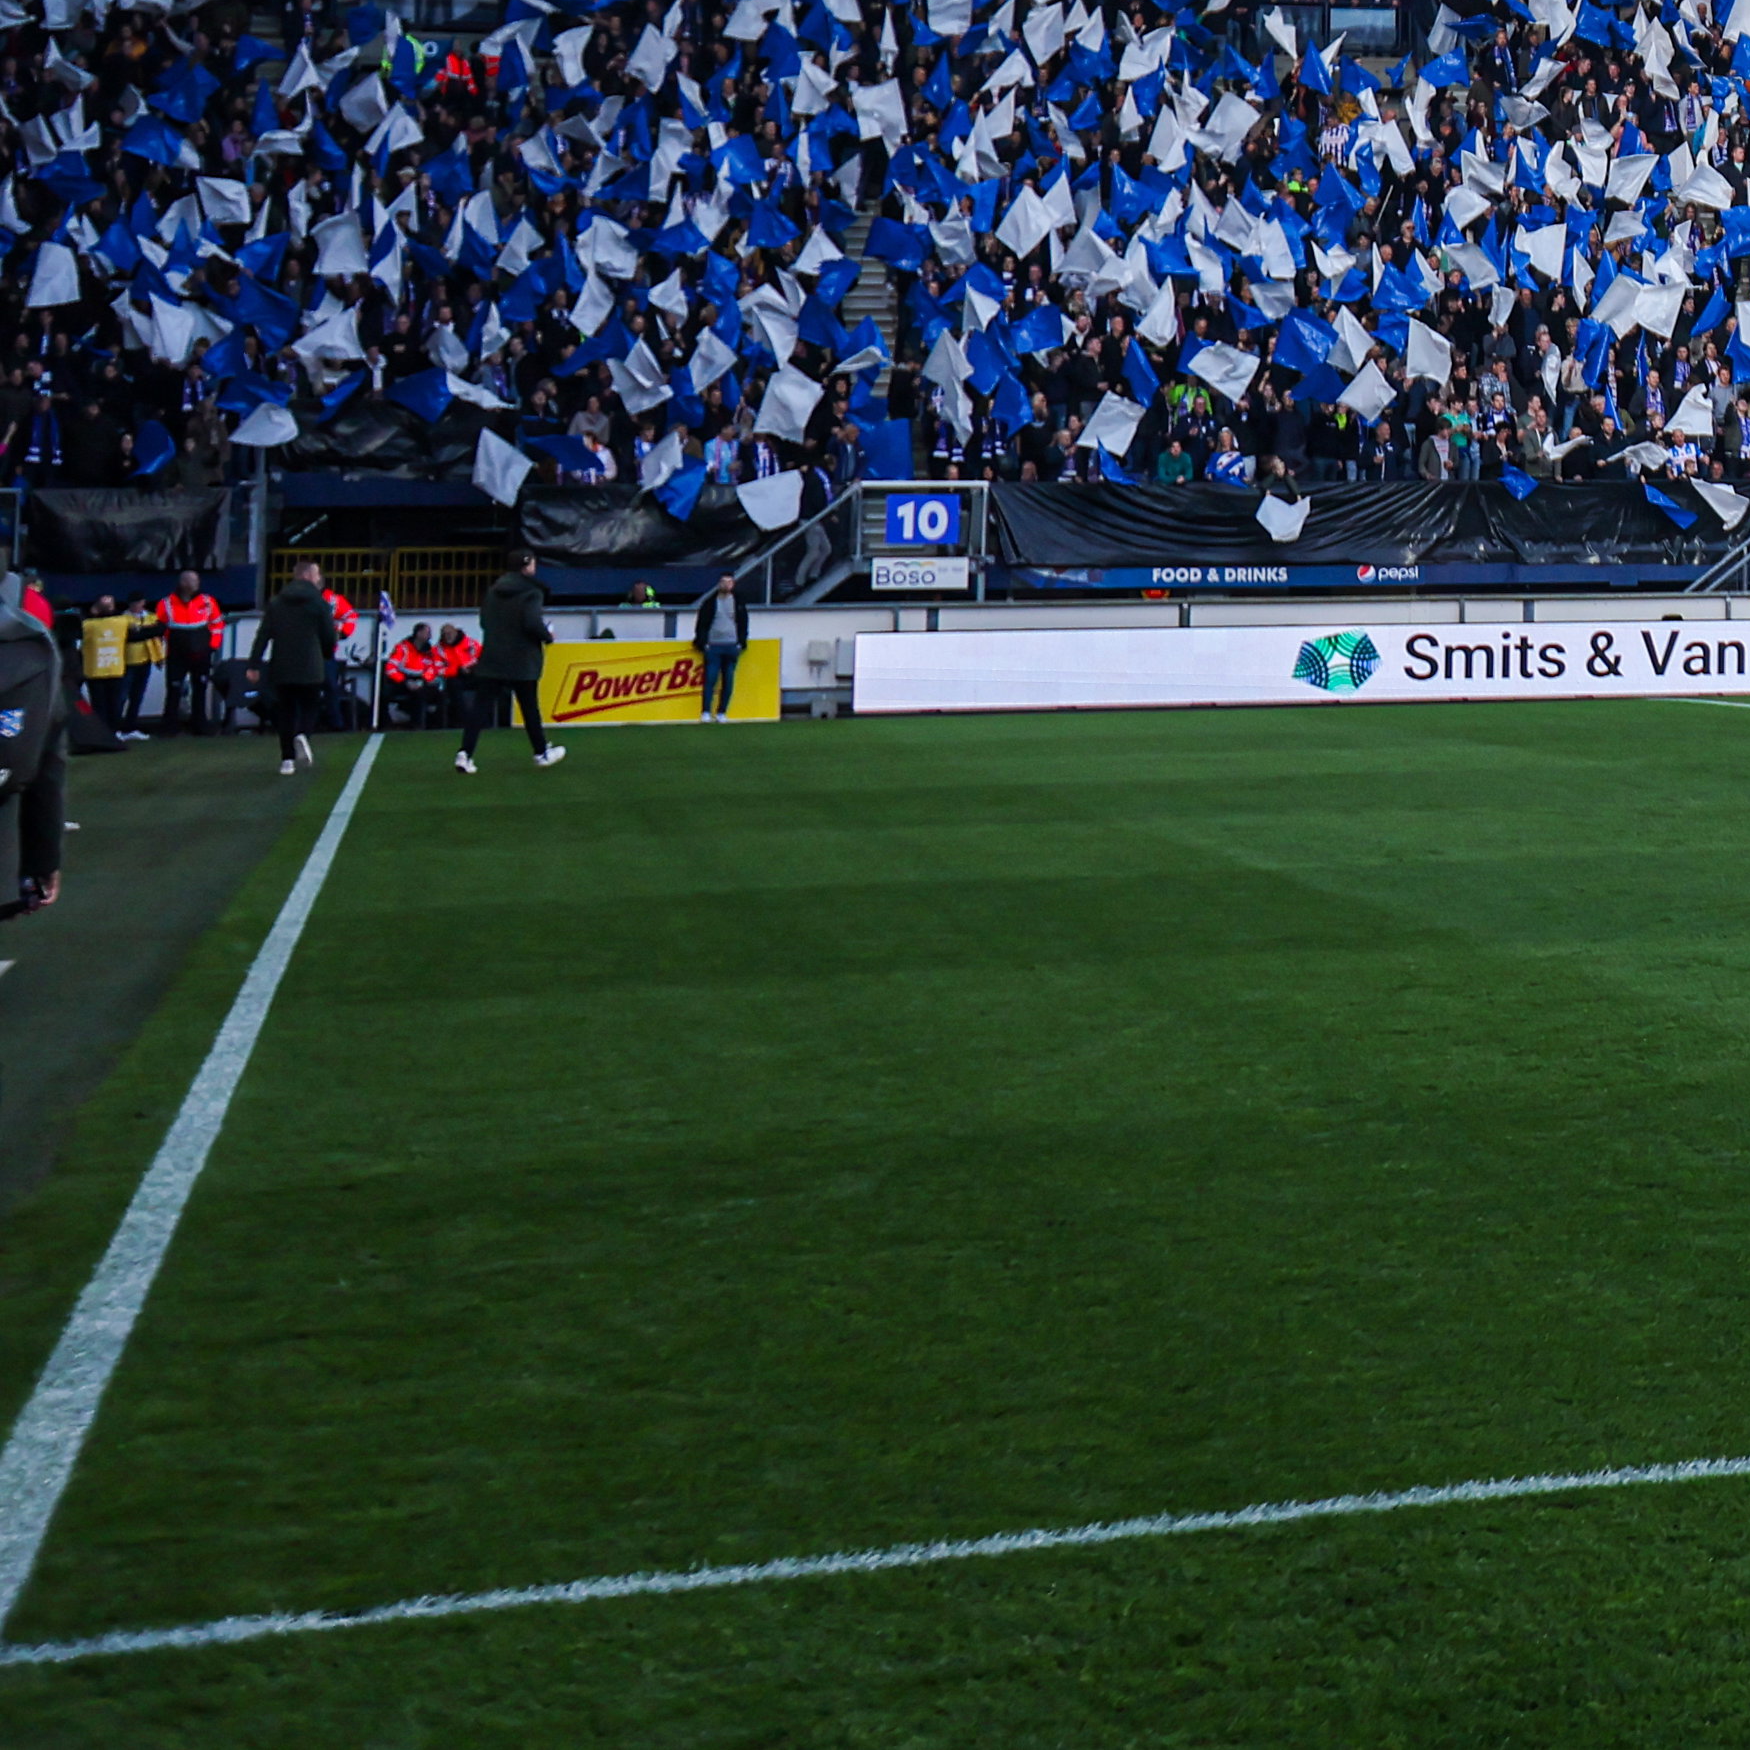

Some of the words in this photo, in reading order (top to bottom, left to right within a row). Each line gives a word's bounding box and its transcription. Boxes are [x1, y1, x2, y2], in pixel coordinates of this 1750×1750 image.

[896, 499, 949, 541] 10
[875, 566, 936, 586] Boso
[1152, 567, 1202, 583] FOOD
[1206, 567, 1220, 582] &
[1224, 566, 1289, 583] DRINKS
[1402, 631, 1567, 681] Smits
[1585, 631, 1624, 678] &
[1640, 629, 1747, 676] Van
